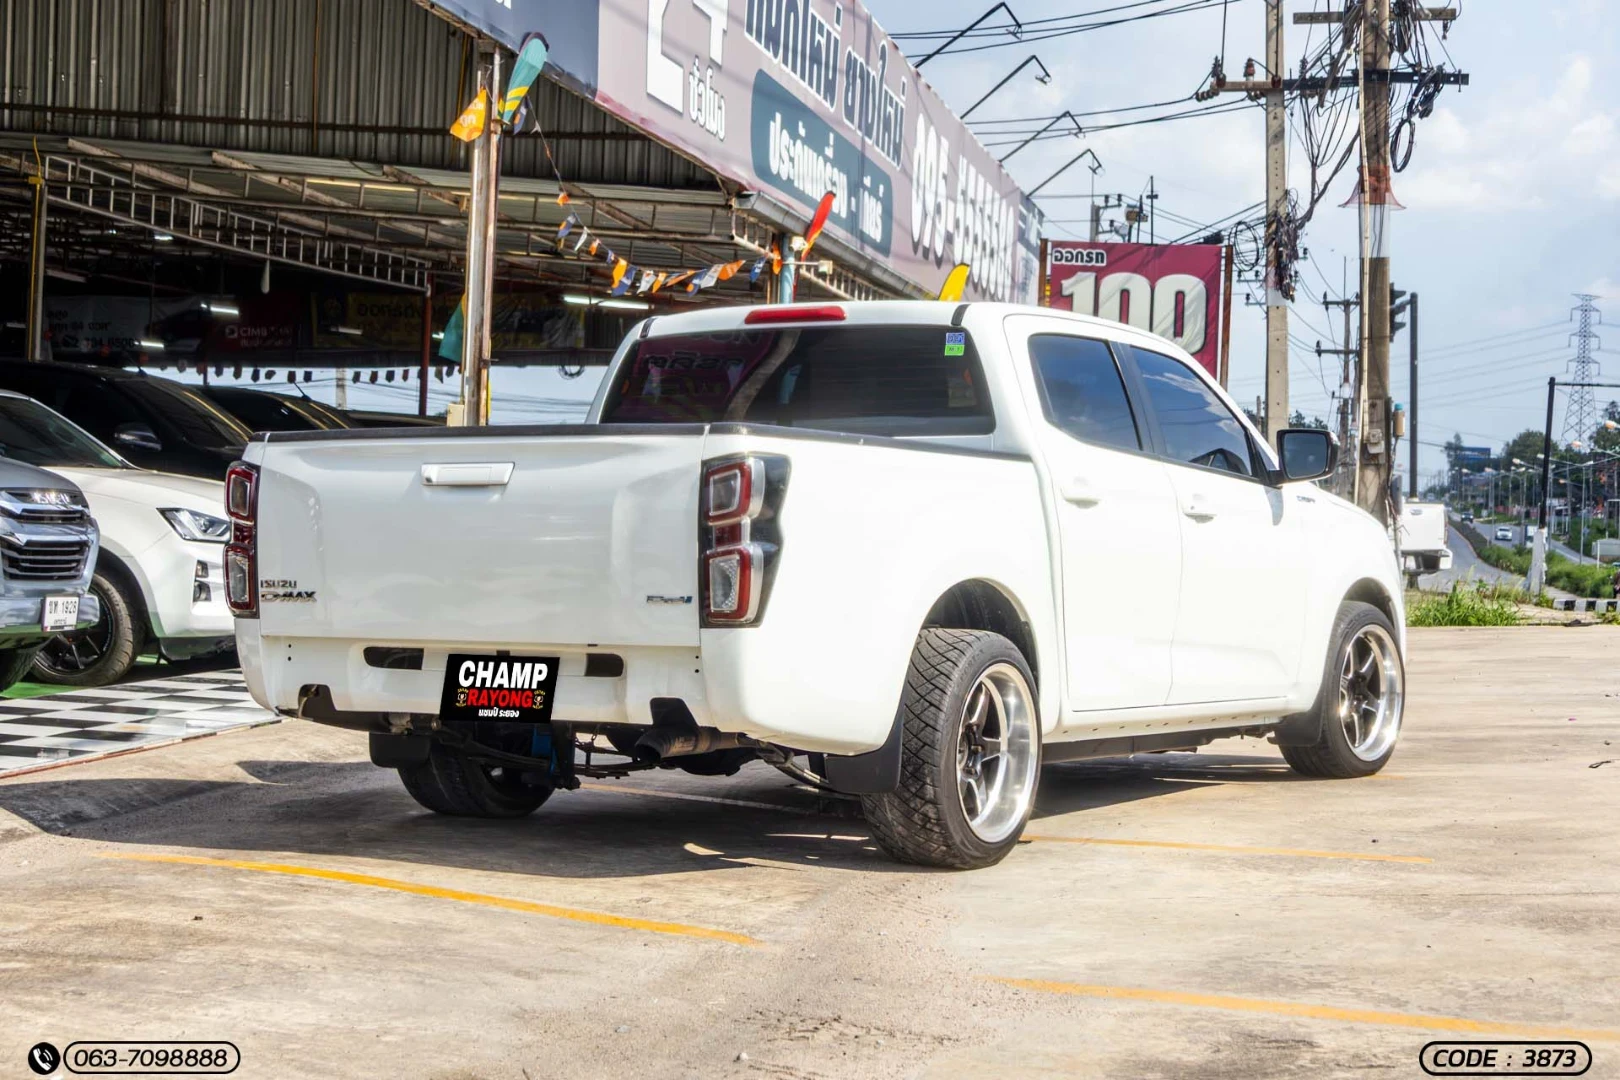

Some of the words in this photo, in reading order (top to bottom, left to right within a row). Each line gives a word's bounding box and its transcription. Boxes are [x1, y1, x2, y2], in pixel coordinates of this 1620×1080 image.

[689, 55, 726, 139] ชั่วโมง
[843, 41, 907, 169] ยางใหม่
[1061, 271, 1208, 355] 100
[260, 580, 297, 589] ISUZU
